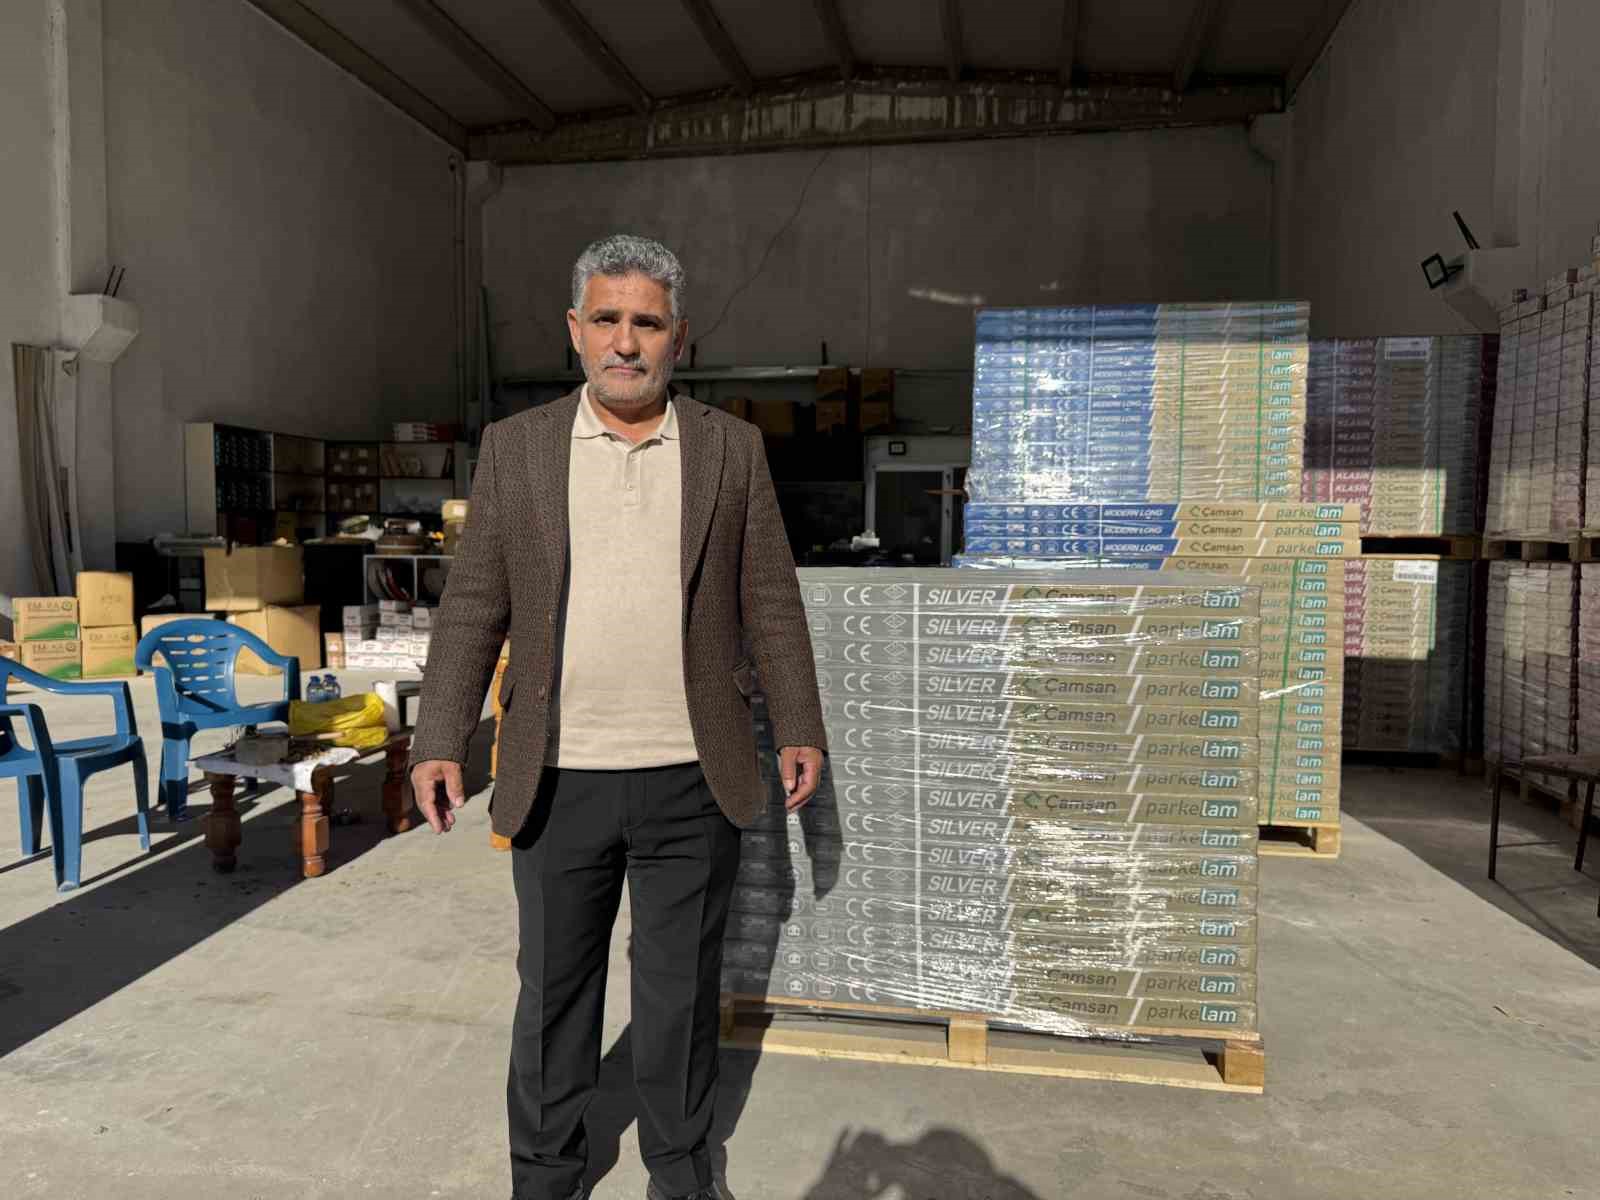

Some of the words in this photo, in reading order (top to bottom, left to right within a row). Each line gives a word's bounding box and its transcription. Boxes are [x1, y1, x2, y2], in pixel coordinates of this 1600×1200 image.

[1276, 506, 1342, 519] parkelam
[1274, 524, 1340, 537] parkelam
[1276, 542, 1342, 555] parkelam
[844, 587, 872, 605] CE
[926, 589, 996, 606] SILVER
[844, 616, 871, 635] CE
[925, 618, 997, 635] SILVER
[844, 644, 872, 663] CE
[926, 647, 995, 664] SILVER
[1146, 650, 1239, 668] parkelam
[844, 673, 872, 692] CE
[926, 677, 996, 692] SILVER
[1145, 681, 1239, 698] parkelam
[926, 705, 996, 722] SILVER
[1145, 710, 1239, 728] parkelam
[1146, 740, 1240, 758] parkelam
[928, 762, 996, 778] SILVER
[1145, 770, 1239, 788] parkelam
[845, 785, 872, 804] CE
[928, 791, 997, 808] SILVER
[1146, 800, 1239, 818] parkelam
[928, 819, 998, 837] SILVER
[928, 847, 997, 865] SILVER
[846, 870, 873, 888] CE
[928, 876, 998, 894] SILVER
[1145, 976, 1237, 995] parkelam
[1146, 1006, 1238, 1025] parkelam
